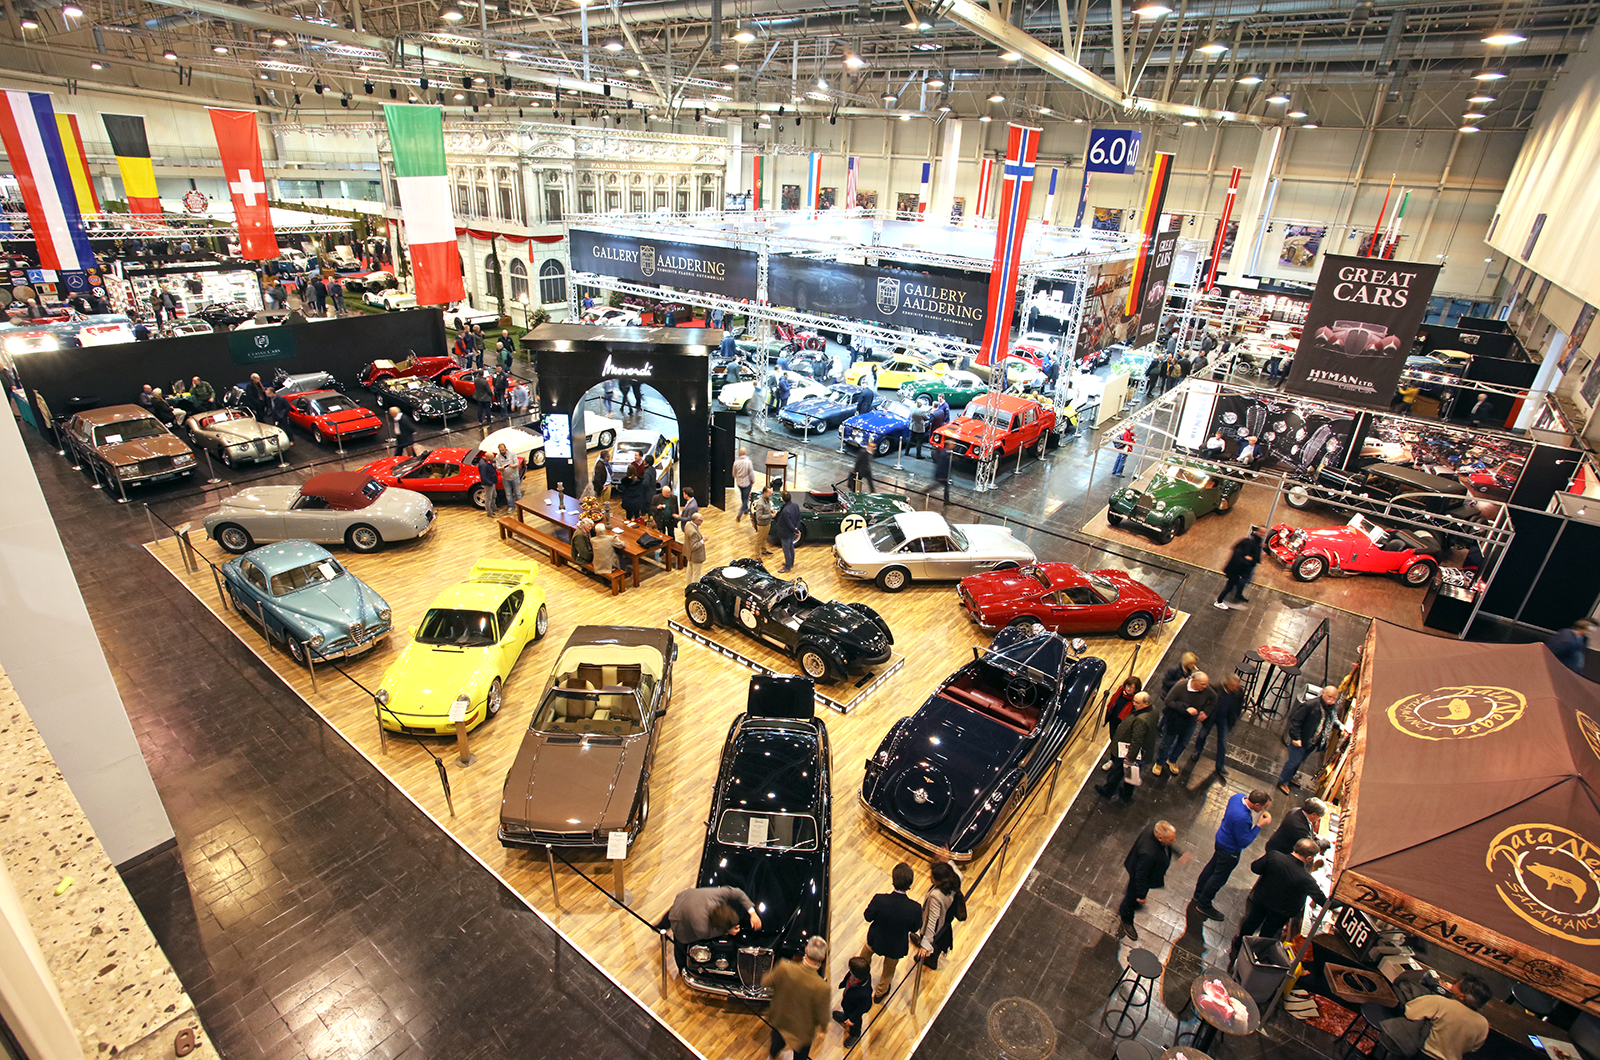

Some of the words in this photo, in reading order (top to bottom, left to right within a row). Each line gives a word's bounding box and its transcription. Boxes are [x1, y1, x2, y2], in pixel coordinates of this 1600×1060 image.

[1090, 136, 1126, 165] 6.0
[1159, 239, 1175, 252] GREAT
[592, 245, 639, 263] GALLERY
[656, 254, 726, 276] AALDERING
[1155, 252, 1172, 268] CARS
[1338, 266, 1418, 288] GREAT
[904, 282, 967, 304] GALLERY
[1333, 282, 1409, 308] CARS
[902, 297, 983, 321] AALDERING
[1309, 368, 1359, 384] HYMAN
[1492, 829, 1554, 875] Pata
[1341, 906, 1371, 948] Café
[1354, 884, 1418, 924] Pata
[1420, 920, 1515, 965] Negra
